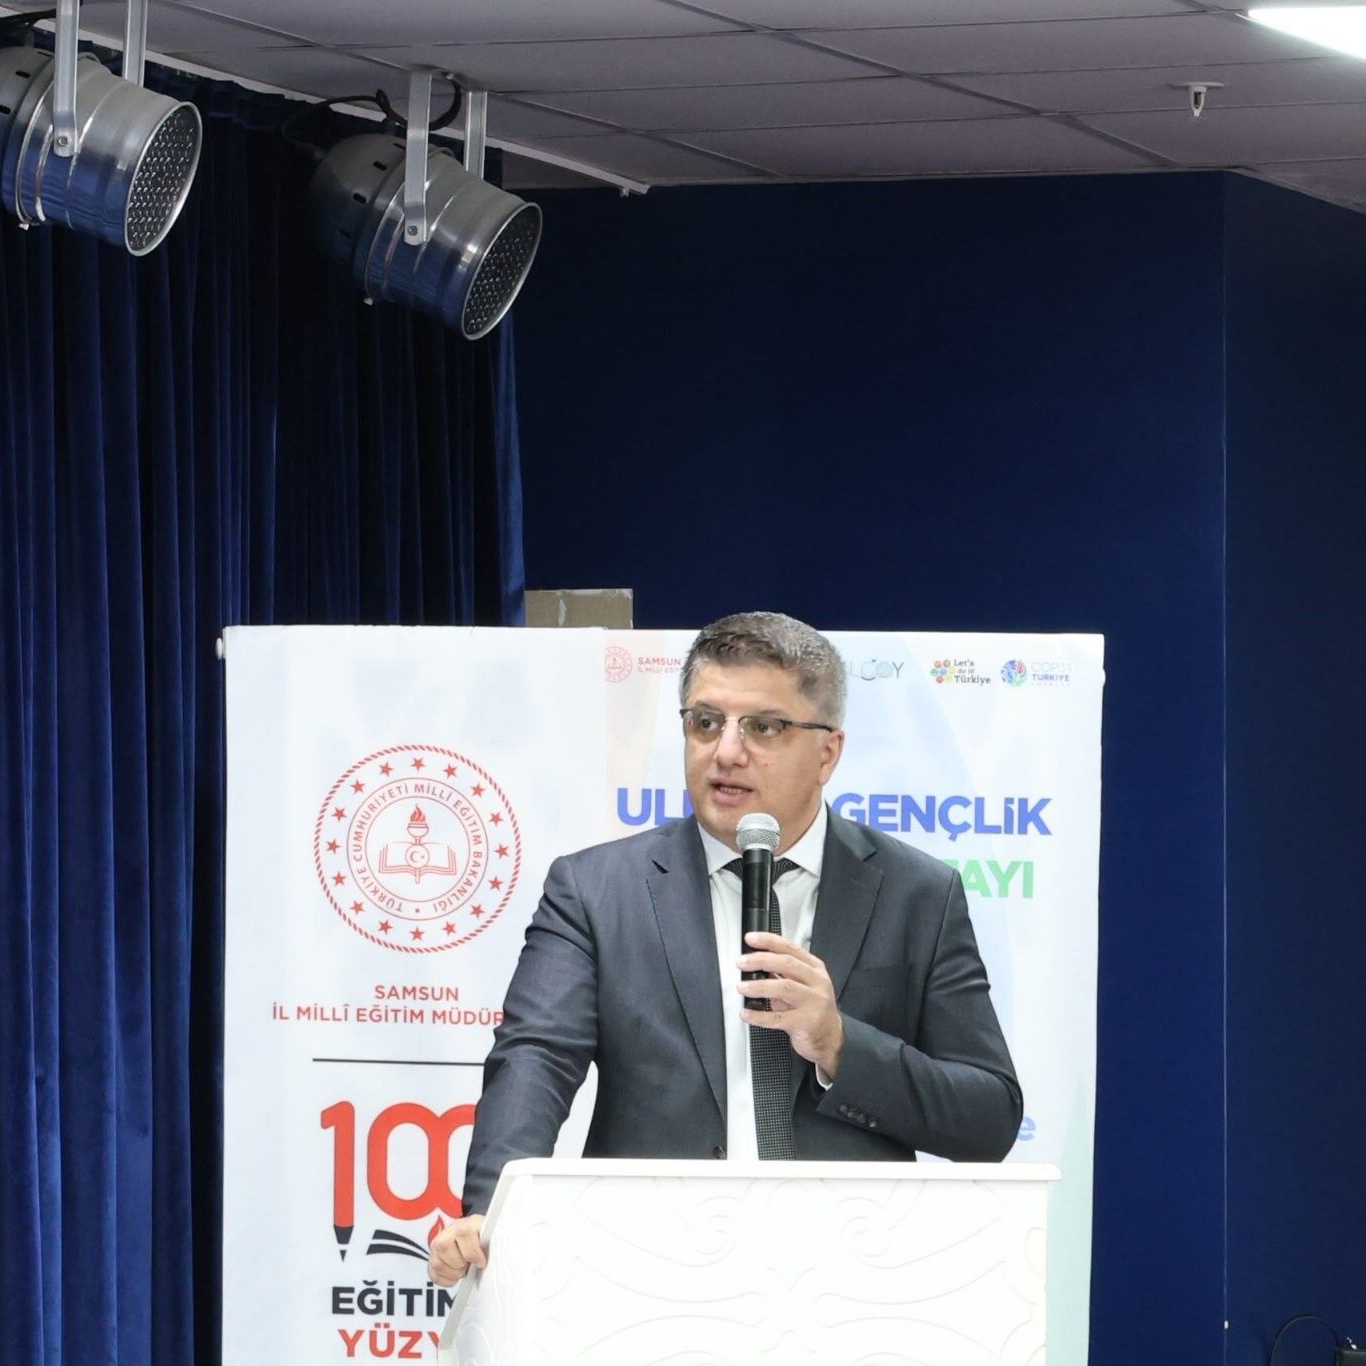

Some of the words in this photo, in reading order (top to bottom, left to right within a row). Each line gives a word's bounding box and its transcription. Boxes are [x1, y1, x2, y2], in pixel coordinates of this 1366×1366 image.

[638, 657, 681, 666] SAMSUN
[954, 659, 975, 667] Let's
[954, 675, 991, 686] Türkiye
[352, 783, 409, 862] CUMHURİYETİ
[453, 799, 483, 845] EĞİTİM
[617, 787, 694, 826] UL
[831, 792, 1053, 842] GENÇLİK
[433, 850, 483, 913] BAKANLIĞI
[943, 858, 1034, 899] AYI
[374, 984, 460, 1002] SAMSUN
[272, 1002, 290, 1020] İL
[356, 1005, 425, 1024] EĞİTİM
